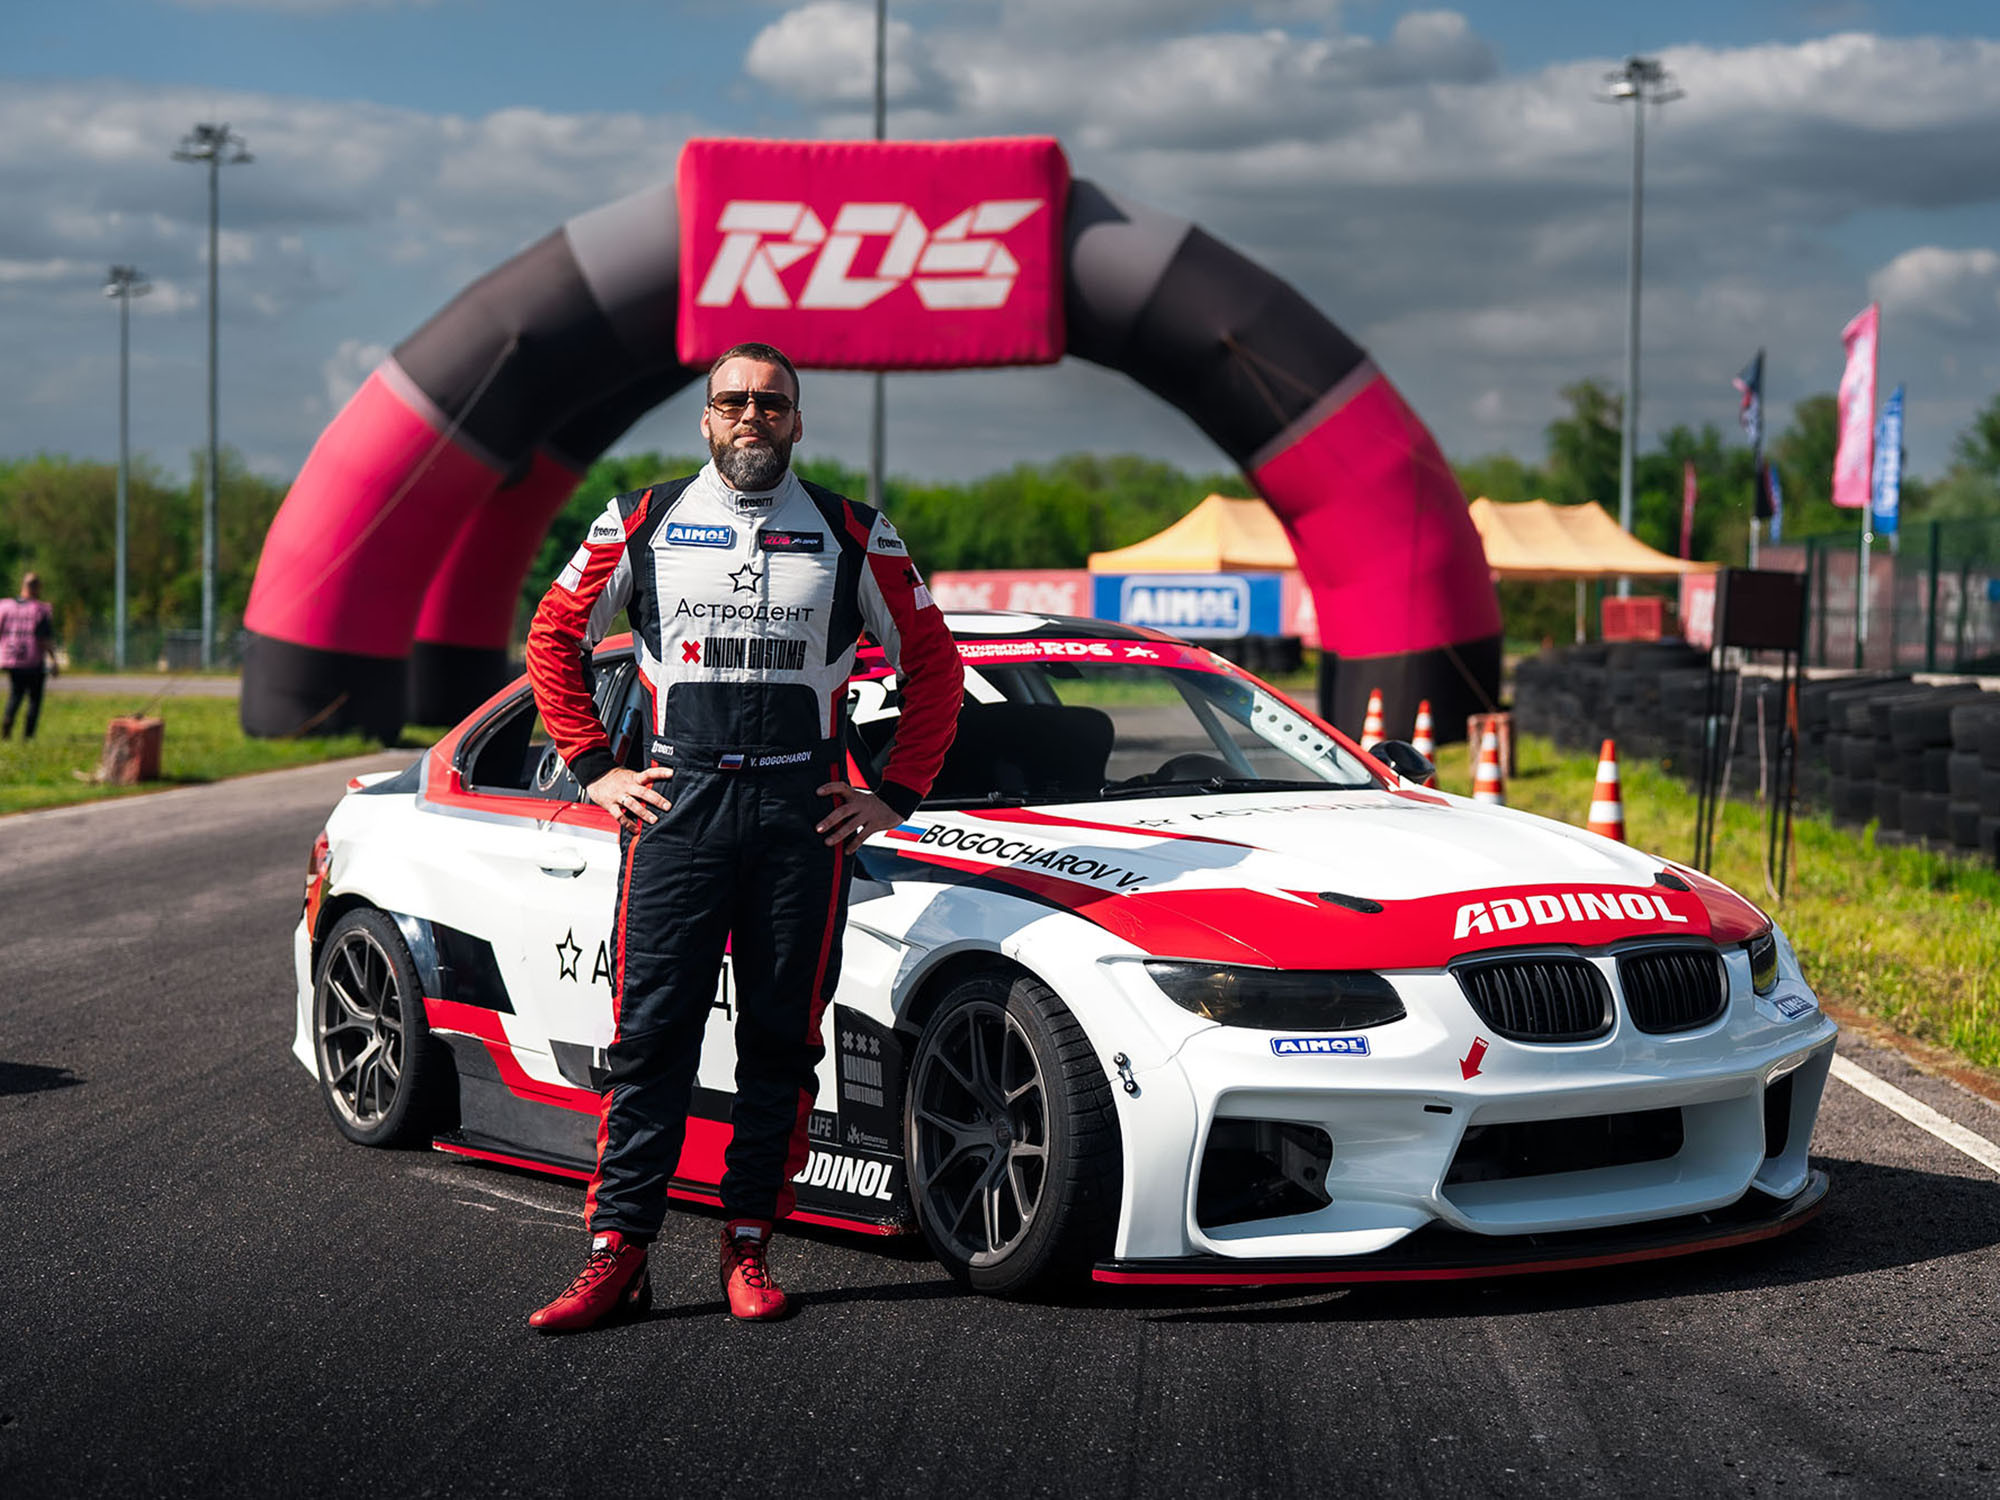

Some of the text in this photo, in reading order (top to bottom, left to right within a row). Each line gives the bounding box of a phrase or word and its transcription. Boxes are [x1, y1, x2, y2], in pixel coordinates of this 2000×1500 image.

[696, 199, 1045, 310] RDS
[669, 528, 729, 541] AIMOL
[674, 597, 815, 623] Астродент
[704, 637, 808, 671] UNION CUSTOMS
[1038, 641, 1113, 656] RDS
[759, 751, 813, 767] BOGOCHAROV
[919, 824, 1149, 892] BOGOCHAROV V.
[1453, 892, 1689, 940] ADDINOL
[1278, 1039, 1364, 1053] AIMOL
[790, 1150, 893, 1201] DDINOL
